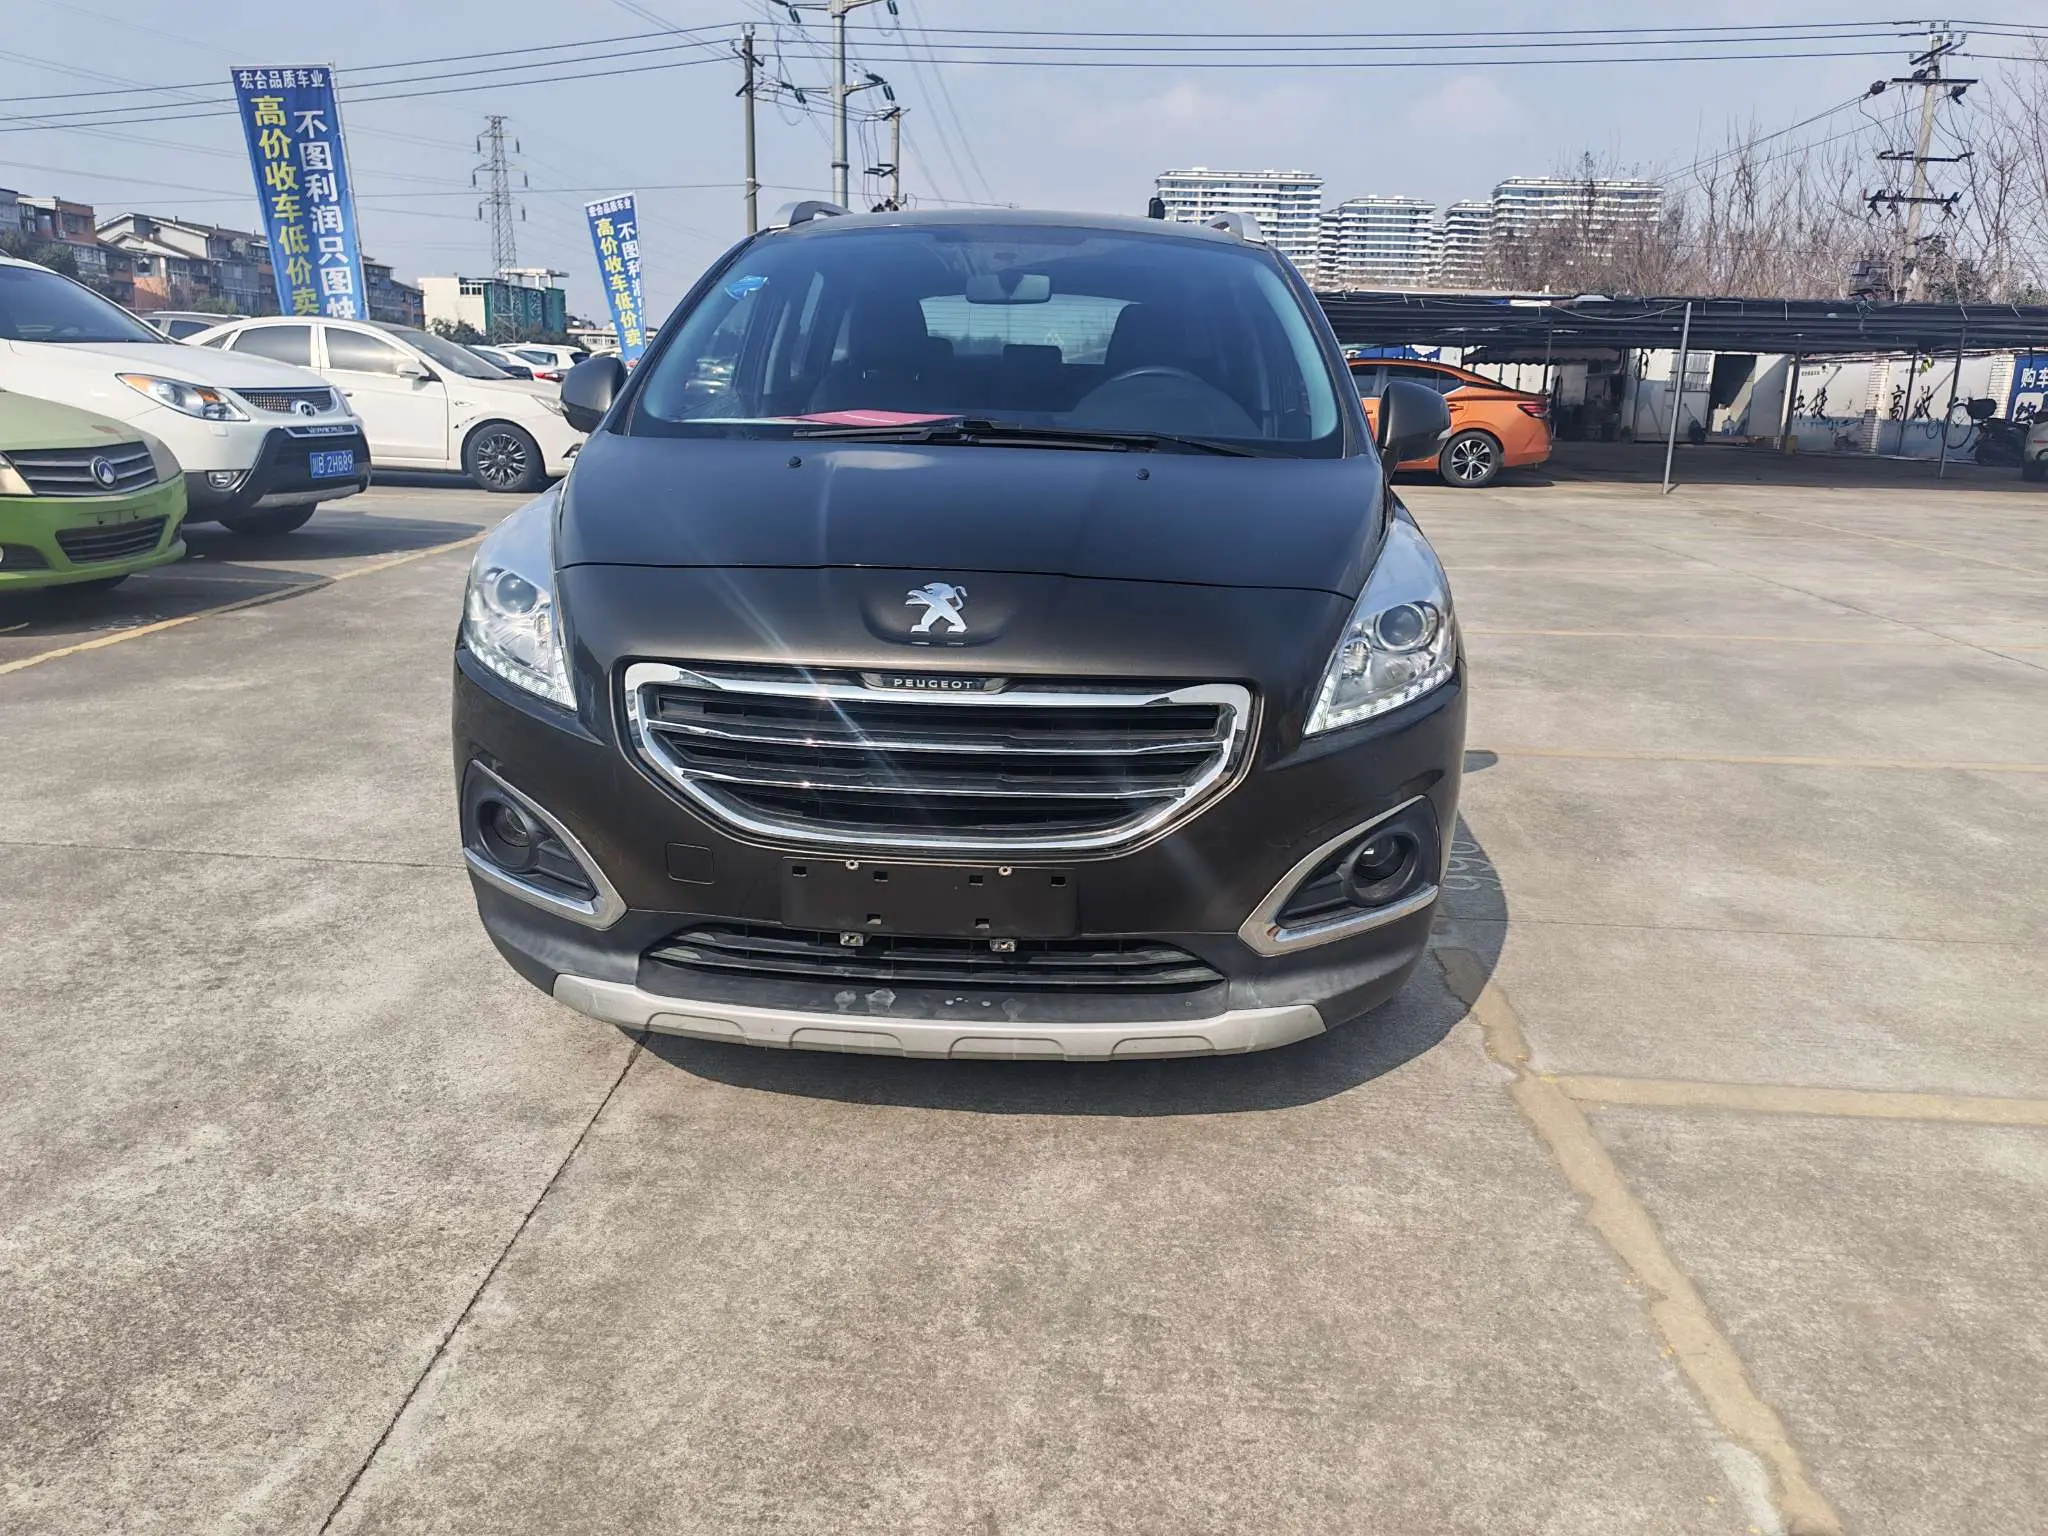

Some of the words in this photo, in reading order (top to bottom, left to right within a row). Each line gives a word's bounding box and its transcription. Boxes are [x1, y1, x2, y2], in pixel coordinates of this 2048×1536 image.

[239, 70, 326, 89] 宏合品质车业
[250, 95, 319, 316] 高价收车低价卖
[594, 218, 641, 347] 高价收车低价卖
[894, 679, 973, 689] PEUGEOT
